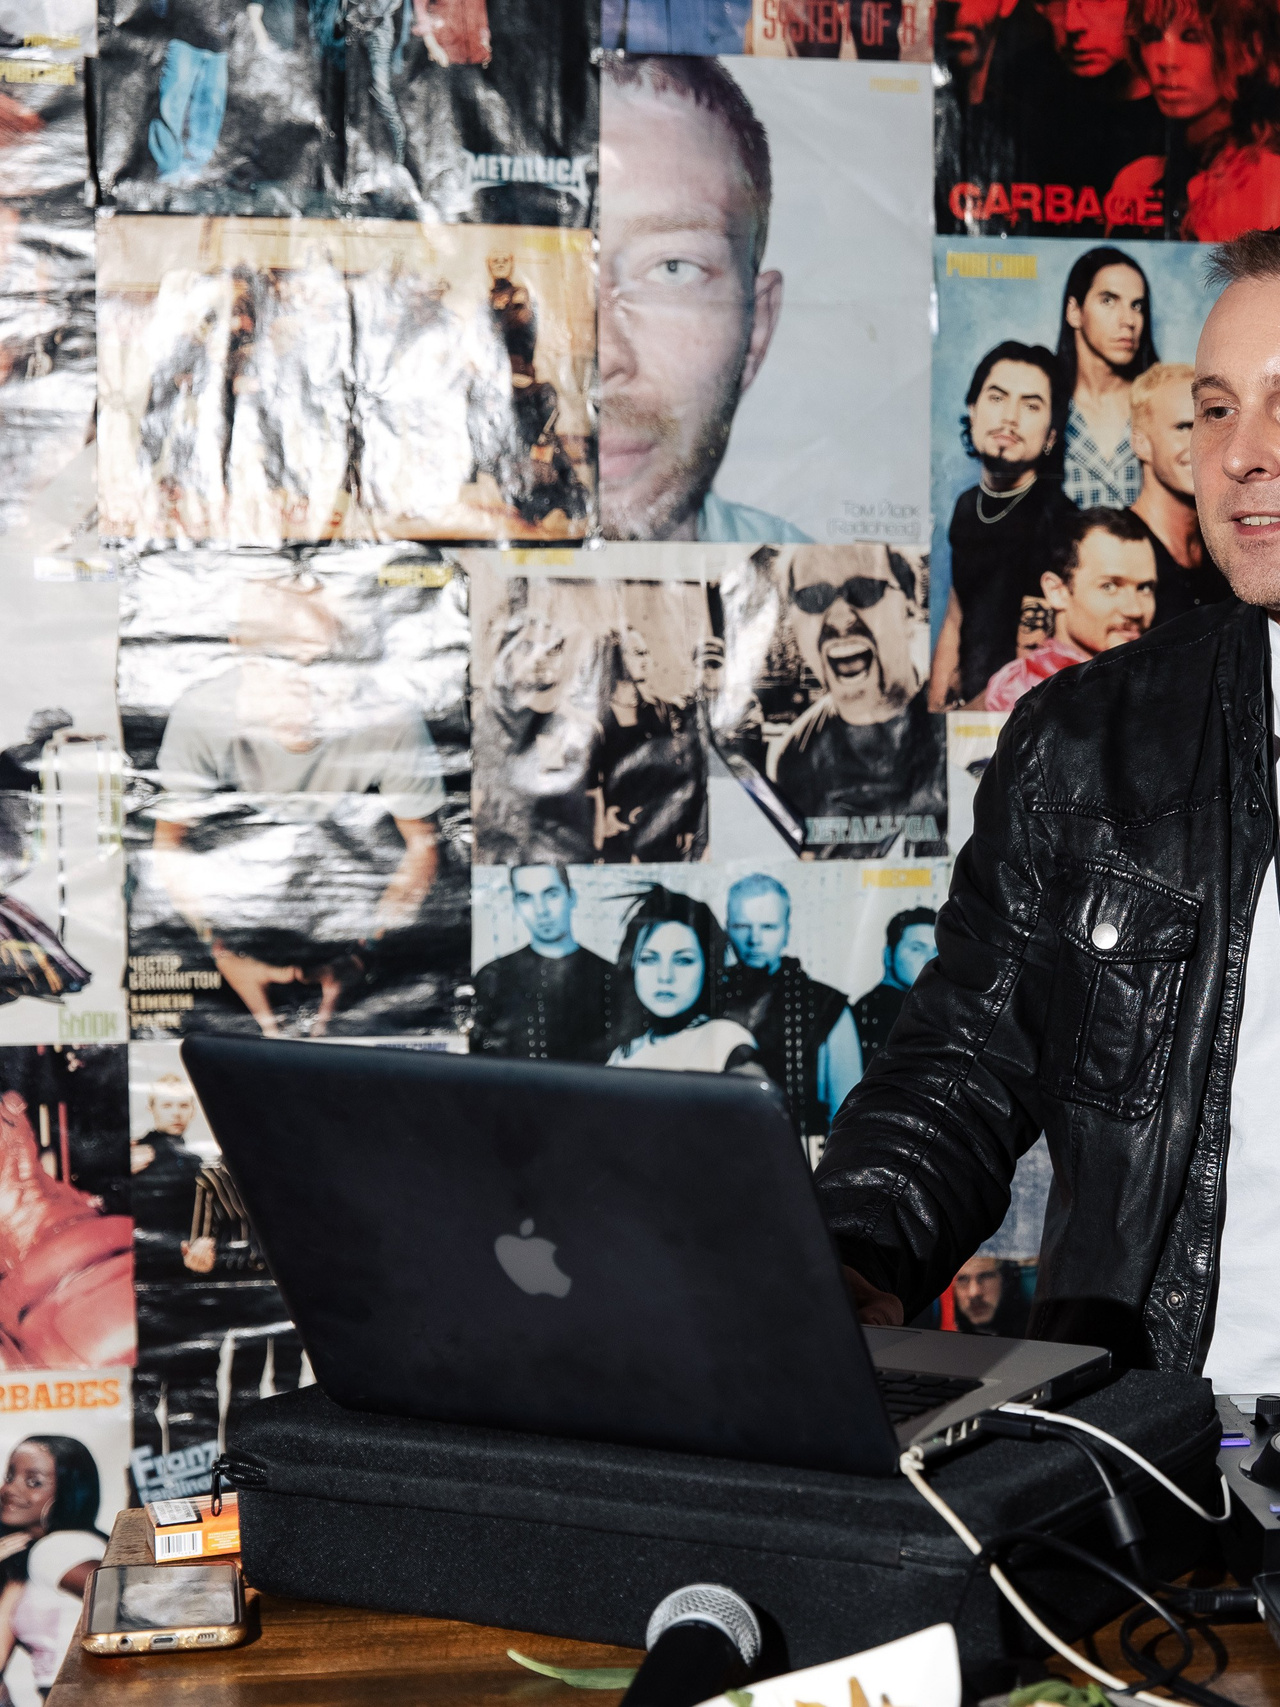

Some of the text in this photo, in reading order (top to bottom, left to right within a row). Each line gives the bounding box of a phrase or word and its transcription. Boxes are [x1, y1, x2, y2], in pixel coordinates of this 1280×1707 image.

[861, 2, 892, 46] OF
[459, 148, 591, 207] METALLICA
[948, 181, 1165, 228] GARBAGE
[130, 1439, 221, 1487] Franz
